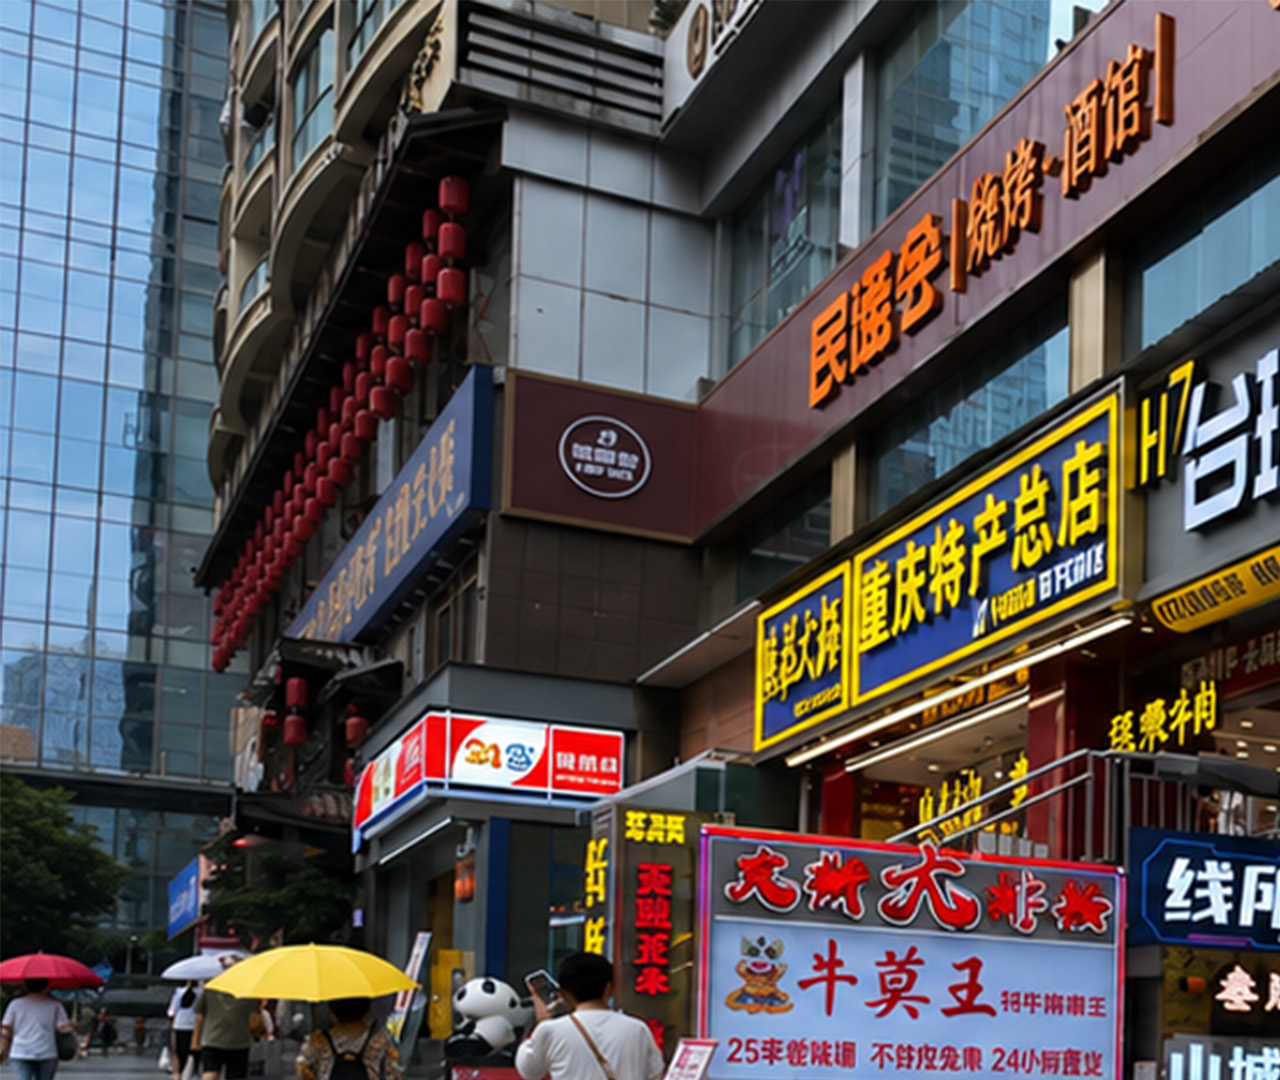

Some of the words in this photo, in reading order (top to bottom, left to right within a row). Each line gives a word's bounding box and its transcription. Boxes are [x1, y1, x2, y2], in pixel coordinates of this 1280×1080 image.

[858, 440, 1102, 652] 重庆特产总店
[797, 938, 997, 1019] 牛莫王
